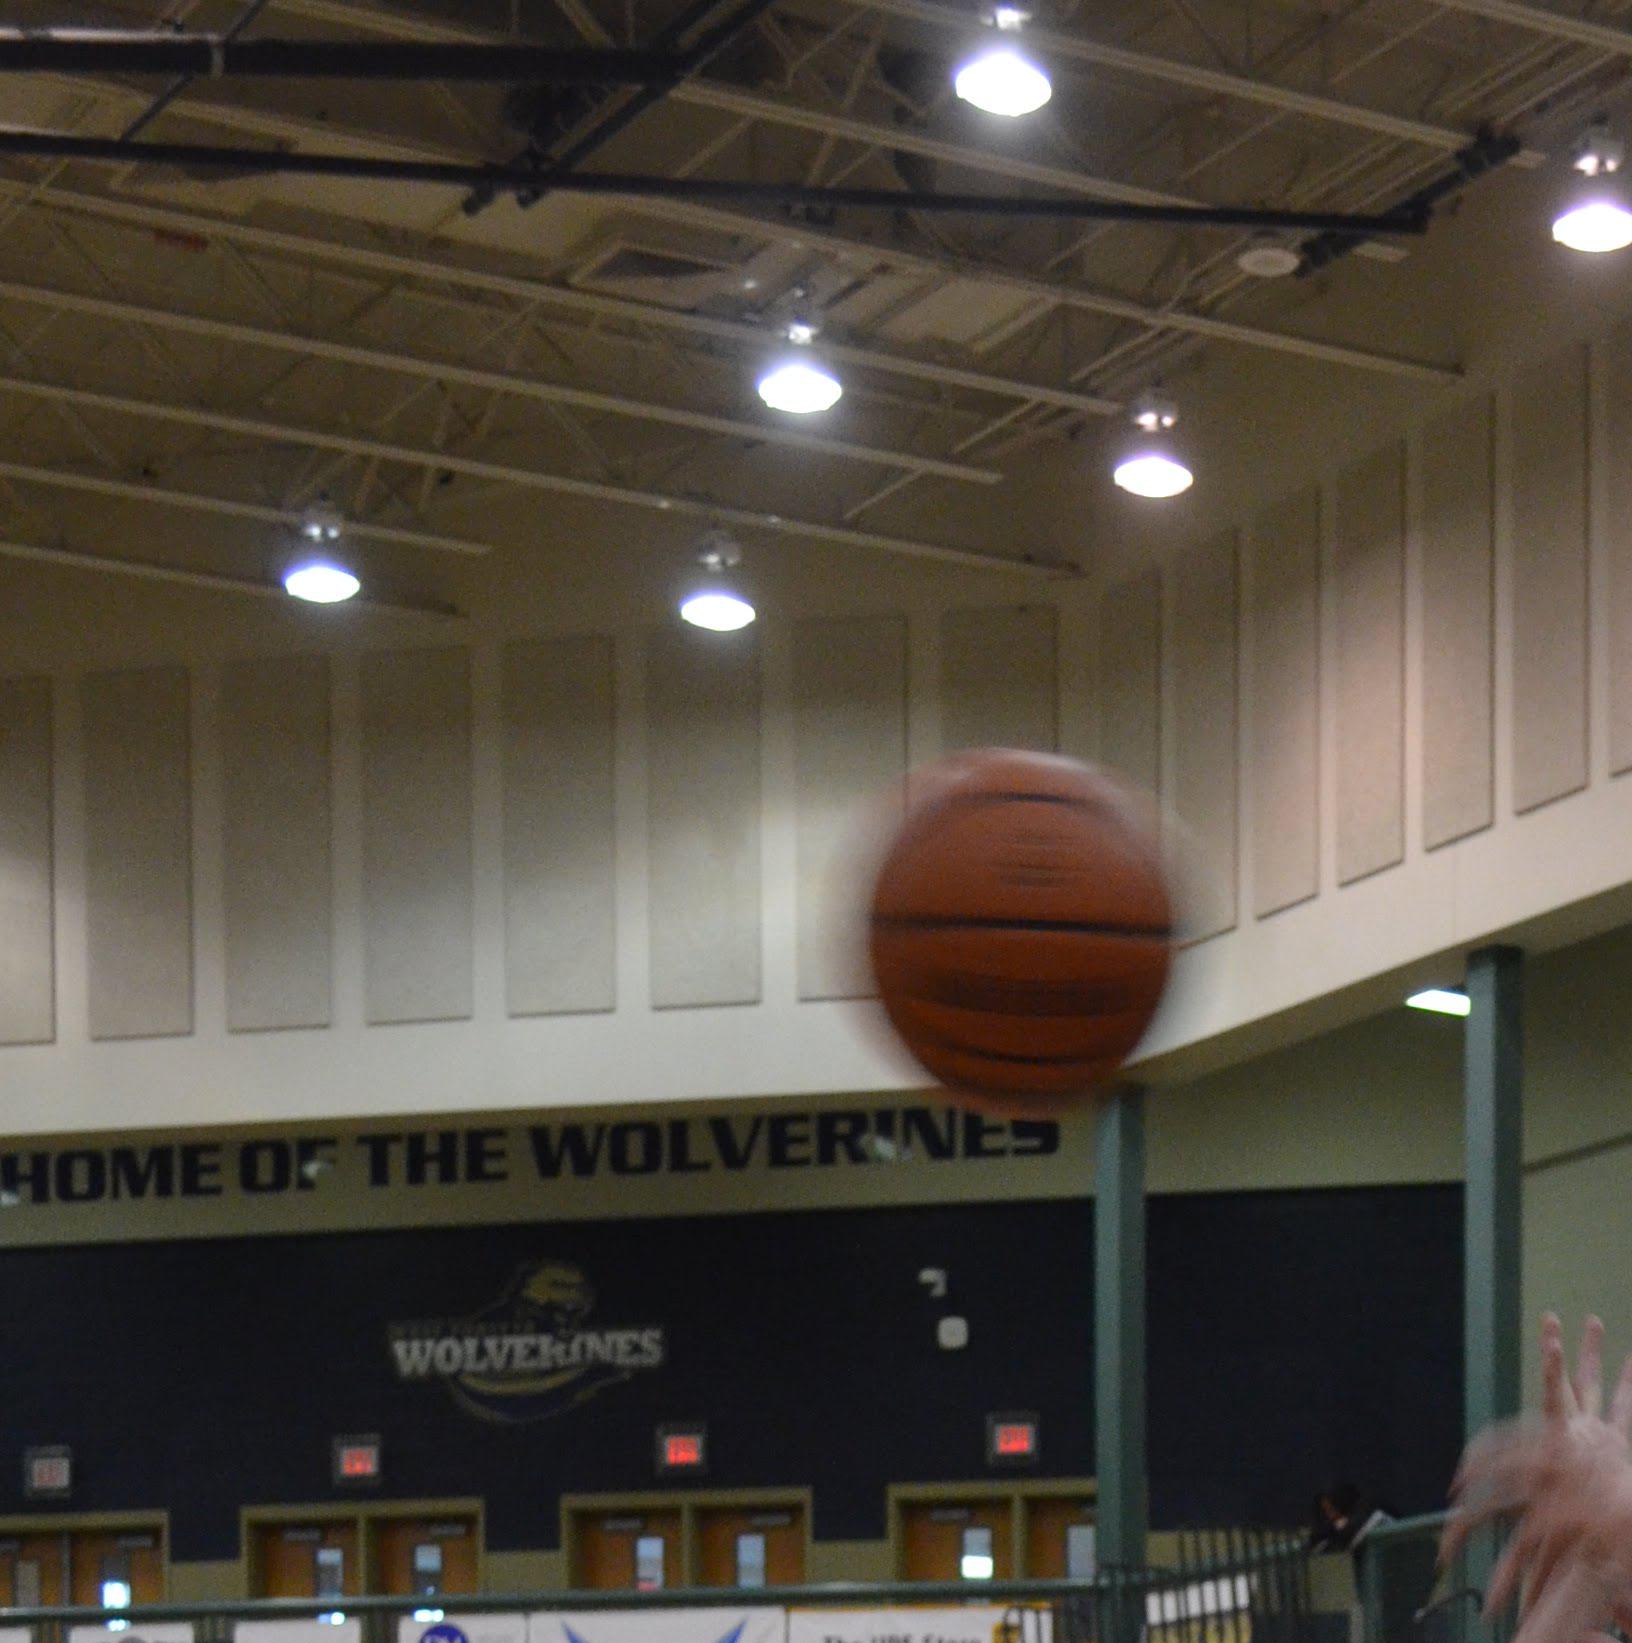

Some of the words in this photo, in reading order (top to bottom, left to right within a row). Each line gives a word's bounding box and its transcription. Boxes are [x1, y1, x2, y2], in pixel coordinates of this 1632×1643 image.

[0, 1143, 223, 1203] HOME
[239, 1136, 339, 1194] OF
[356, 1127, 509, 1187] THE
[529, 1106, 1061, 1179] WOLVERINES
